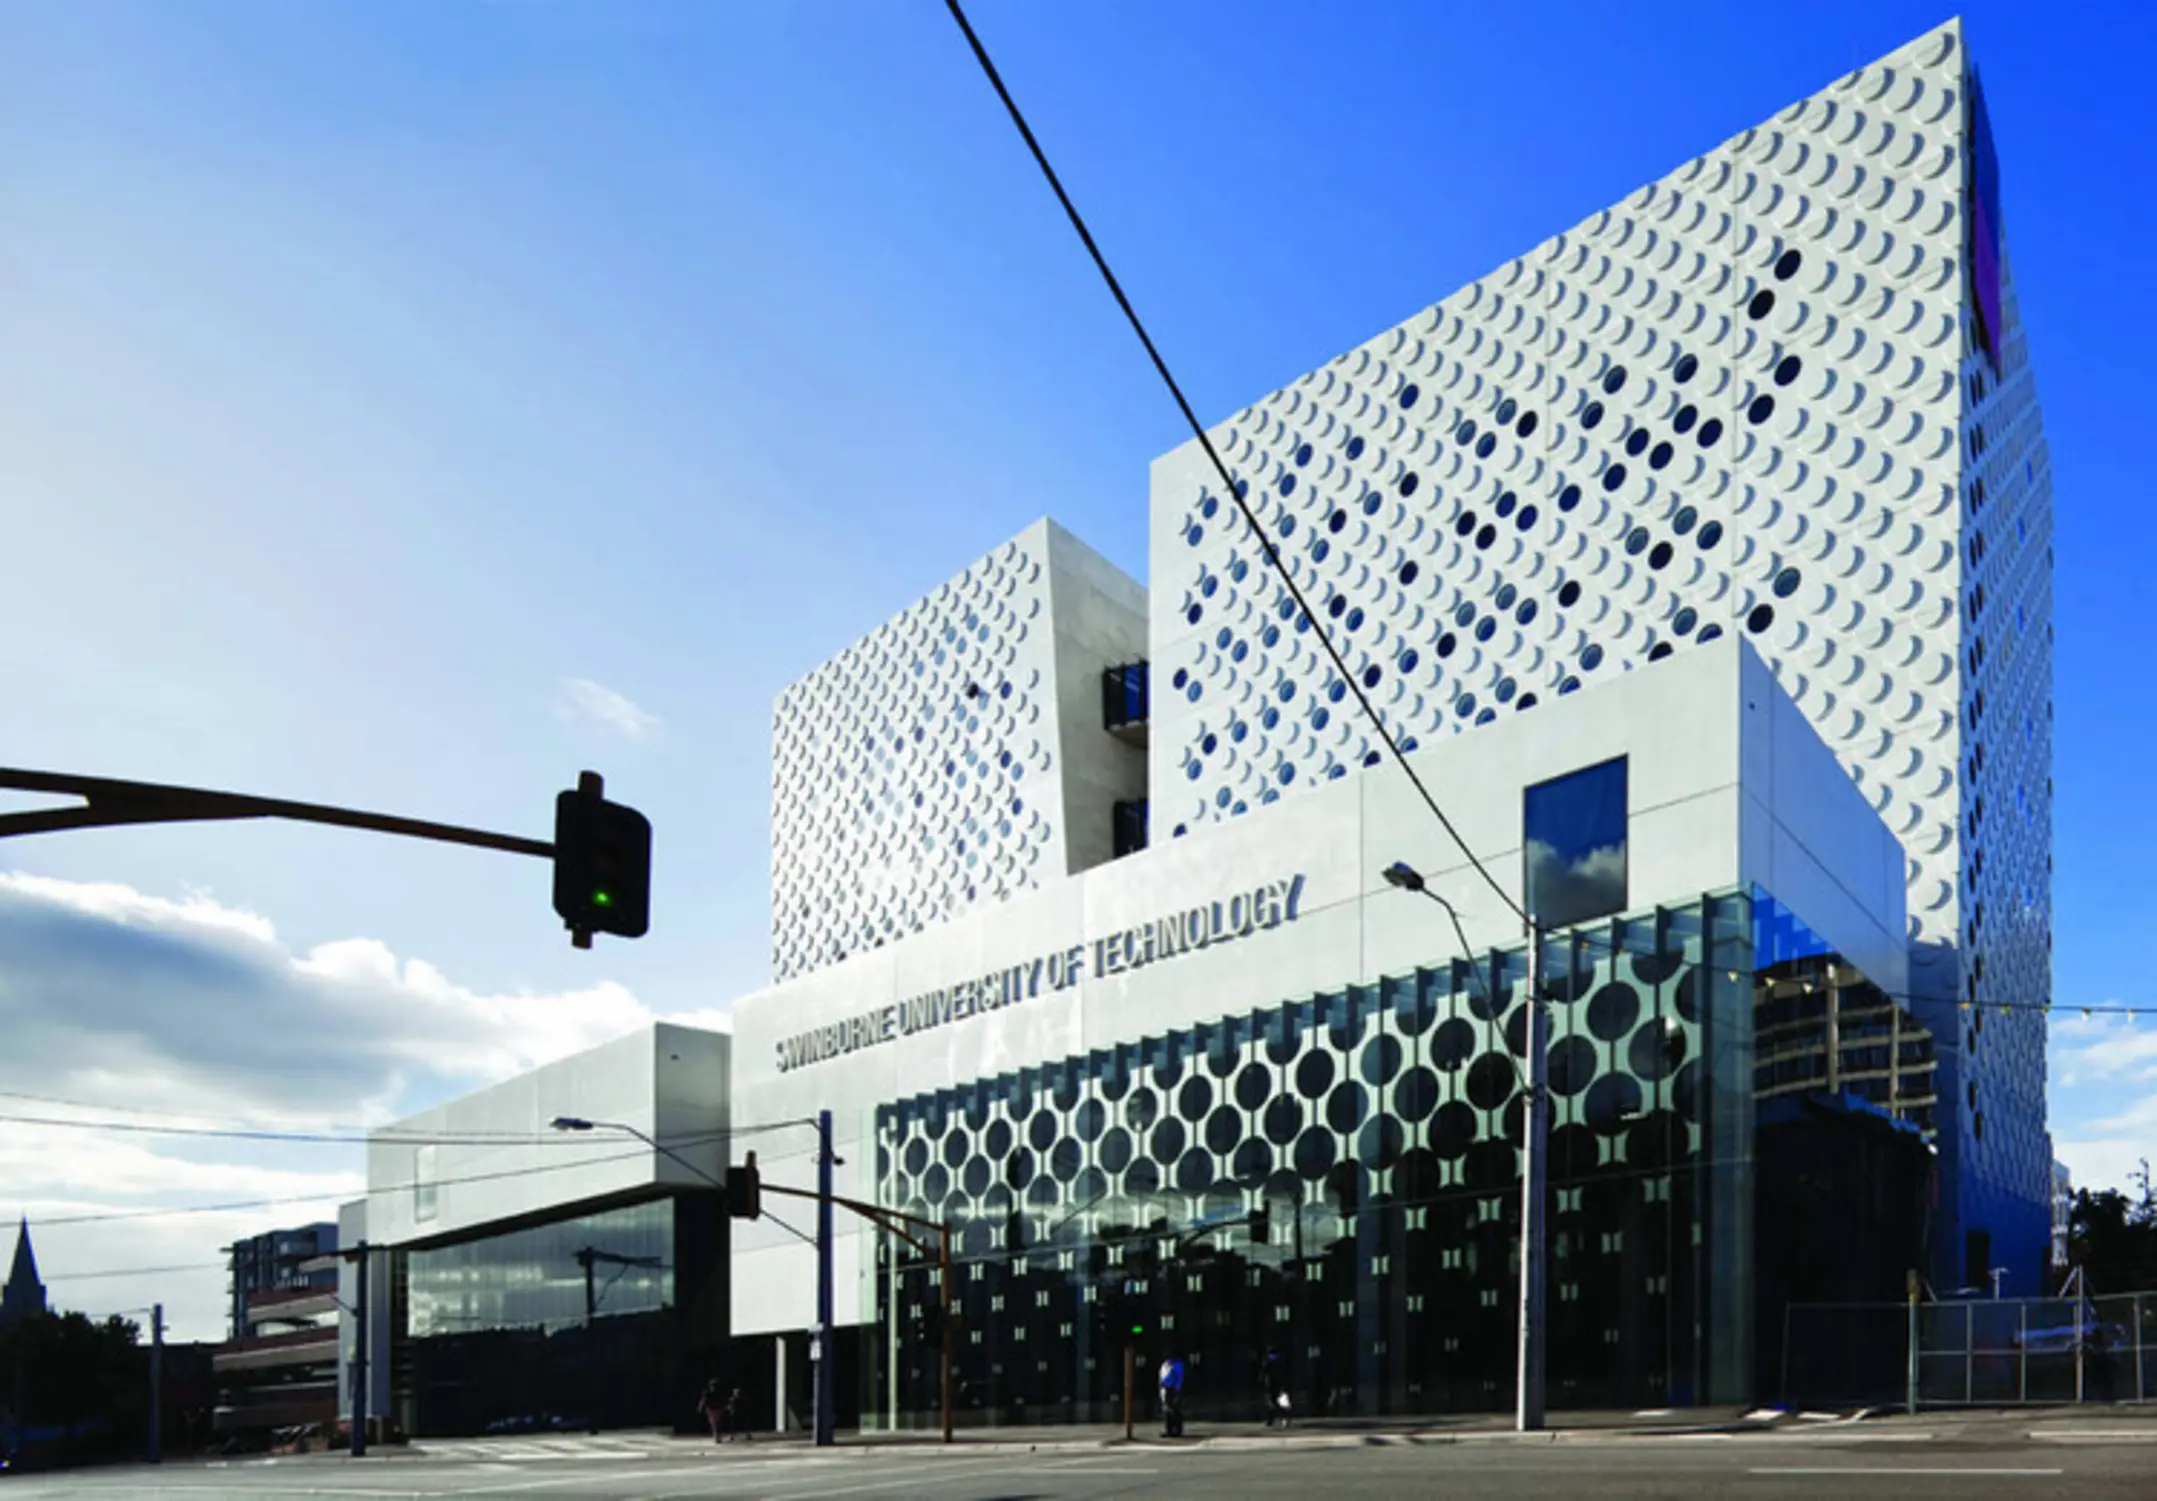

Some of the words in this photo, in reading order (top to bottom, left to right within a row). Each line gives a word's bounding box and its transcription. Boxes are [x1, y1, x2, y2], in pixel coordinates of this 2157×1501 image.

[776, 1004, 897, 1073] SWINBURNE
[898, 957, 1044, 1036] UNIVERSITY
[1047, 943, 1085, 991] OF
[1089, 872, 1305, 979] TECHNOLOGY
